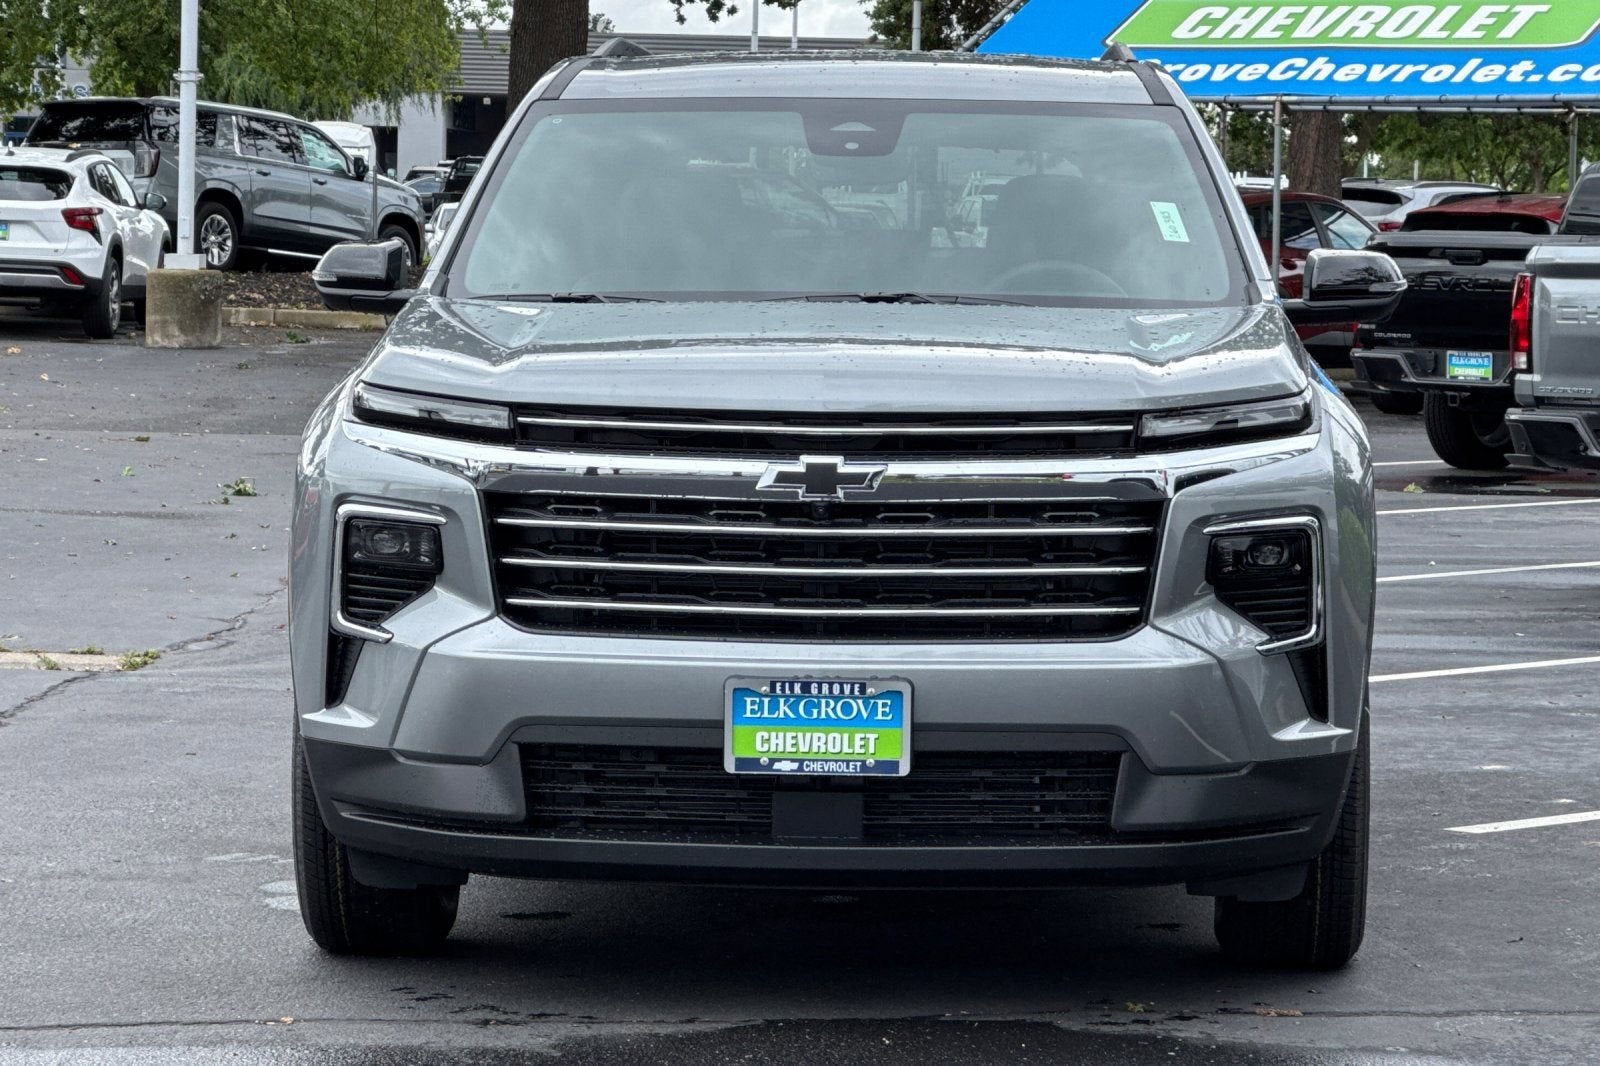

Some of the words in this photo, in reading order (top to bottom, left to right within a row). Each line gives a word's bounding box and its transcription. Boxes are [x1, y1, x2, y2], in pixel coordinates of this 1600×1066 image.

[1170, 5, 1552, 39] CHEVROLET
[776, 682, 801, 694] ELK
[810, 683, 861, 695] GROVE
[743, 697, 796, 719] ELK
[798, 698, 893, 720] GROVE
[755, 731, 879, 755] CHEVROLET
[803, 761, 862, 773] CHEVROLET
